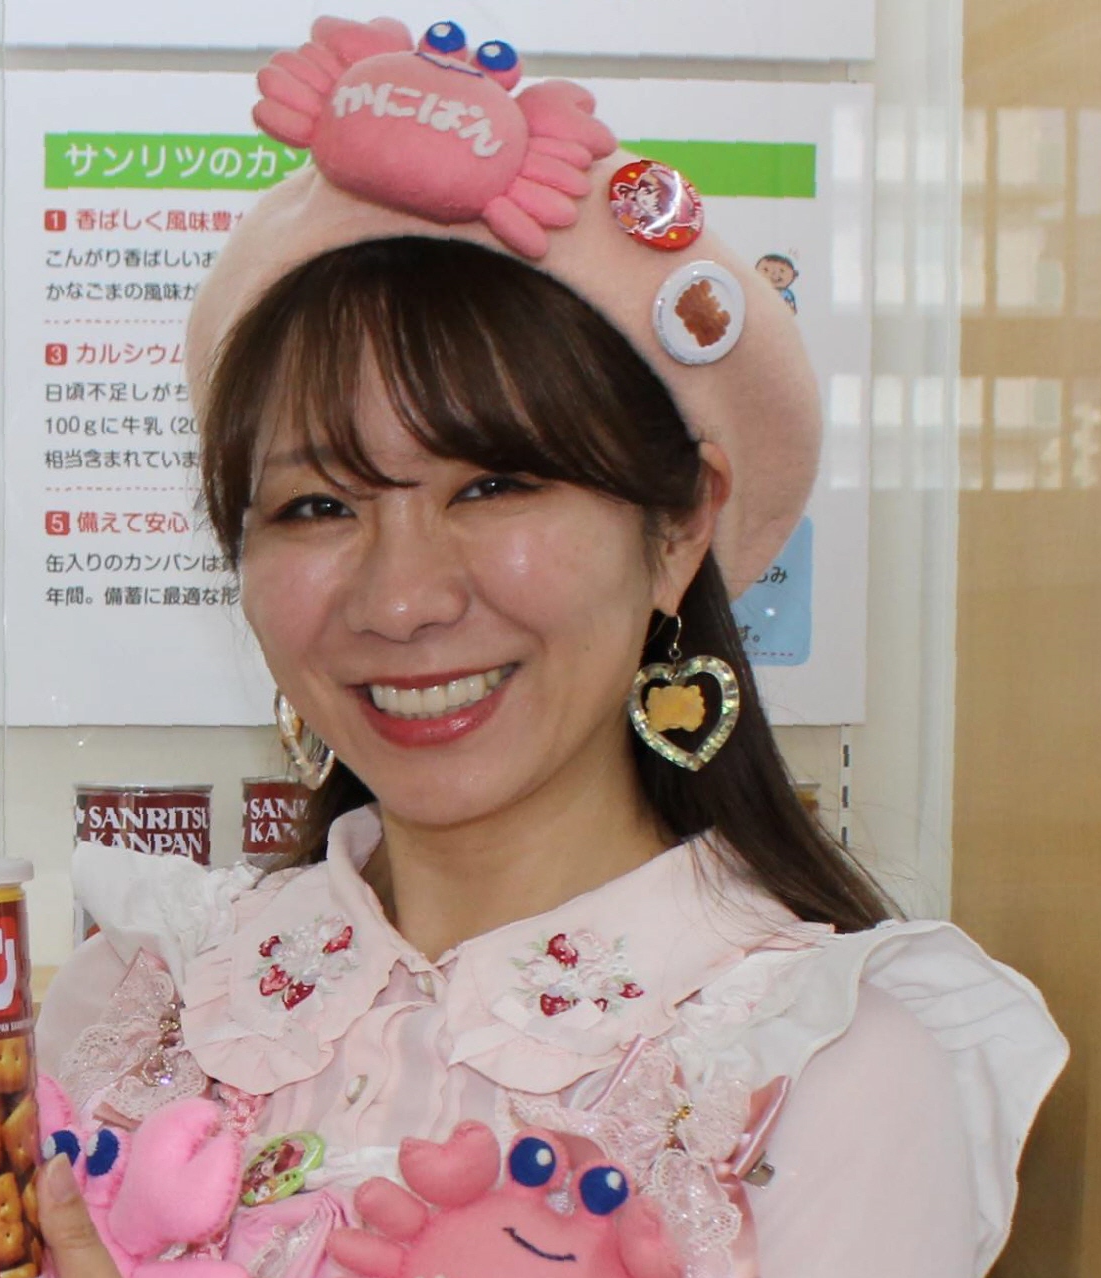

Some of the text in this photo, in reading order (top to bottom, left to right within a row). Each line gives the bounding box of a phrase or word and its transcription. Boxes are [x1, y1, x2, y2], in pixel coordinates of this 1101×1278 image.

[332, 82, 504, 158] かにぱん
[78, 511, 189, 534] 備えて安心
